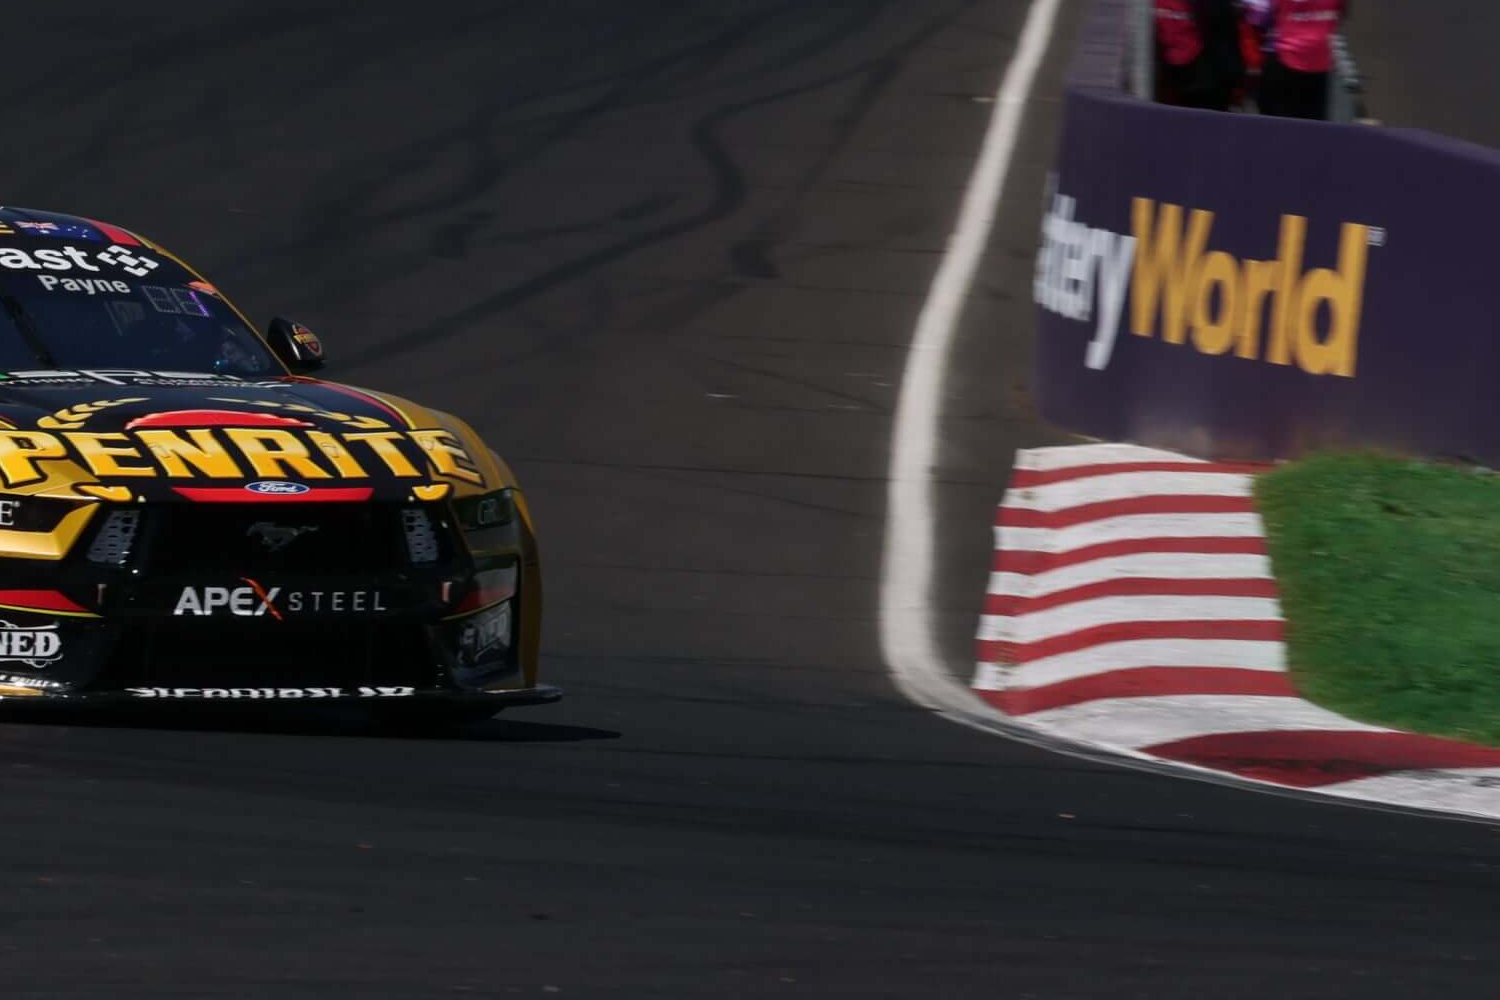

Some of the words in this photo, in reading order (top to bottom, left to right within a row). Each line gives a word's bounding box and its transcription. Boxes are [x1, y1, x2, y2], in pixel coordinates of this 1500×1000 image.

[38, 275, 131, 295] Payne
[257, 482, 300, 494] Ford
[173, 577, 284, 622] APEX
[288, 591, 387, 612] STEEL
